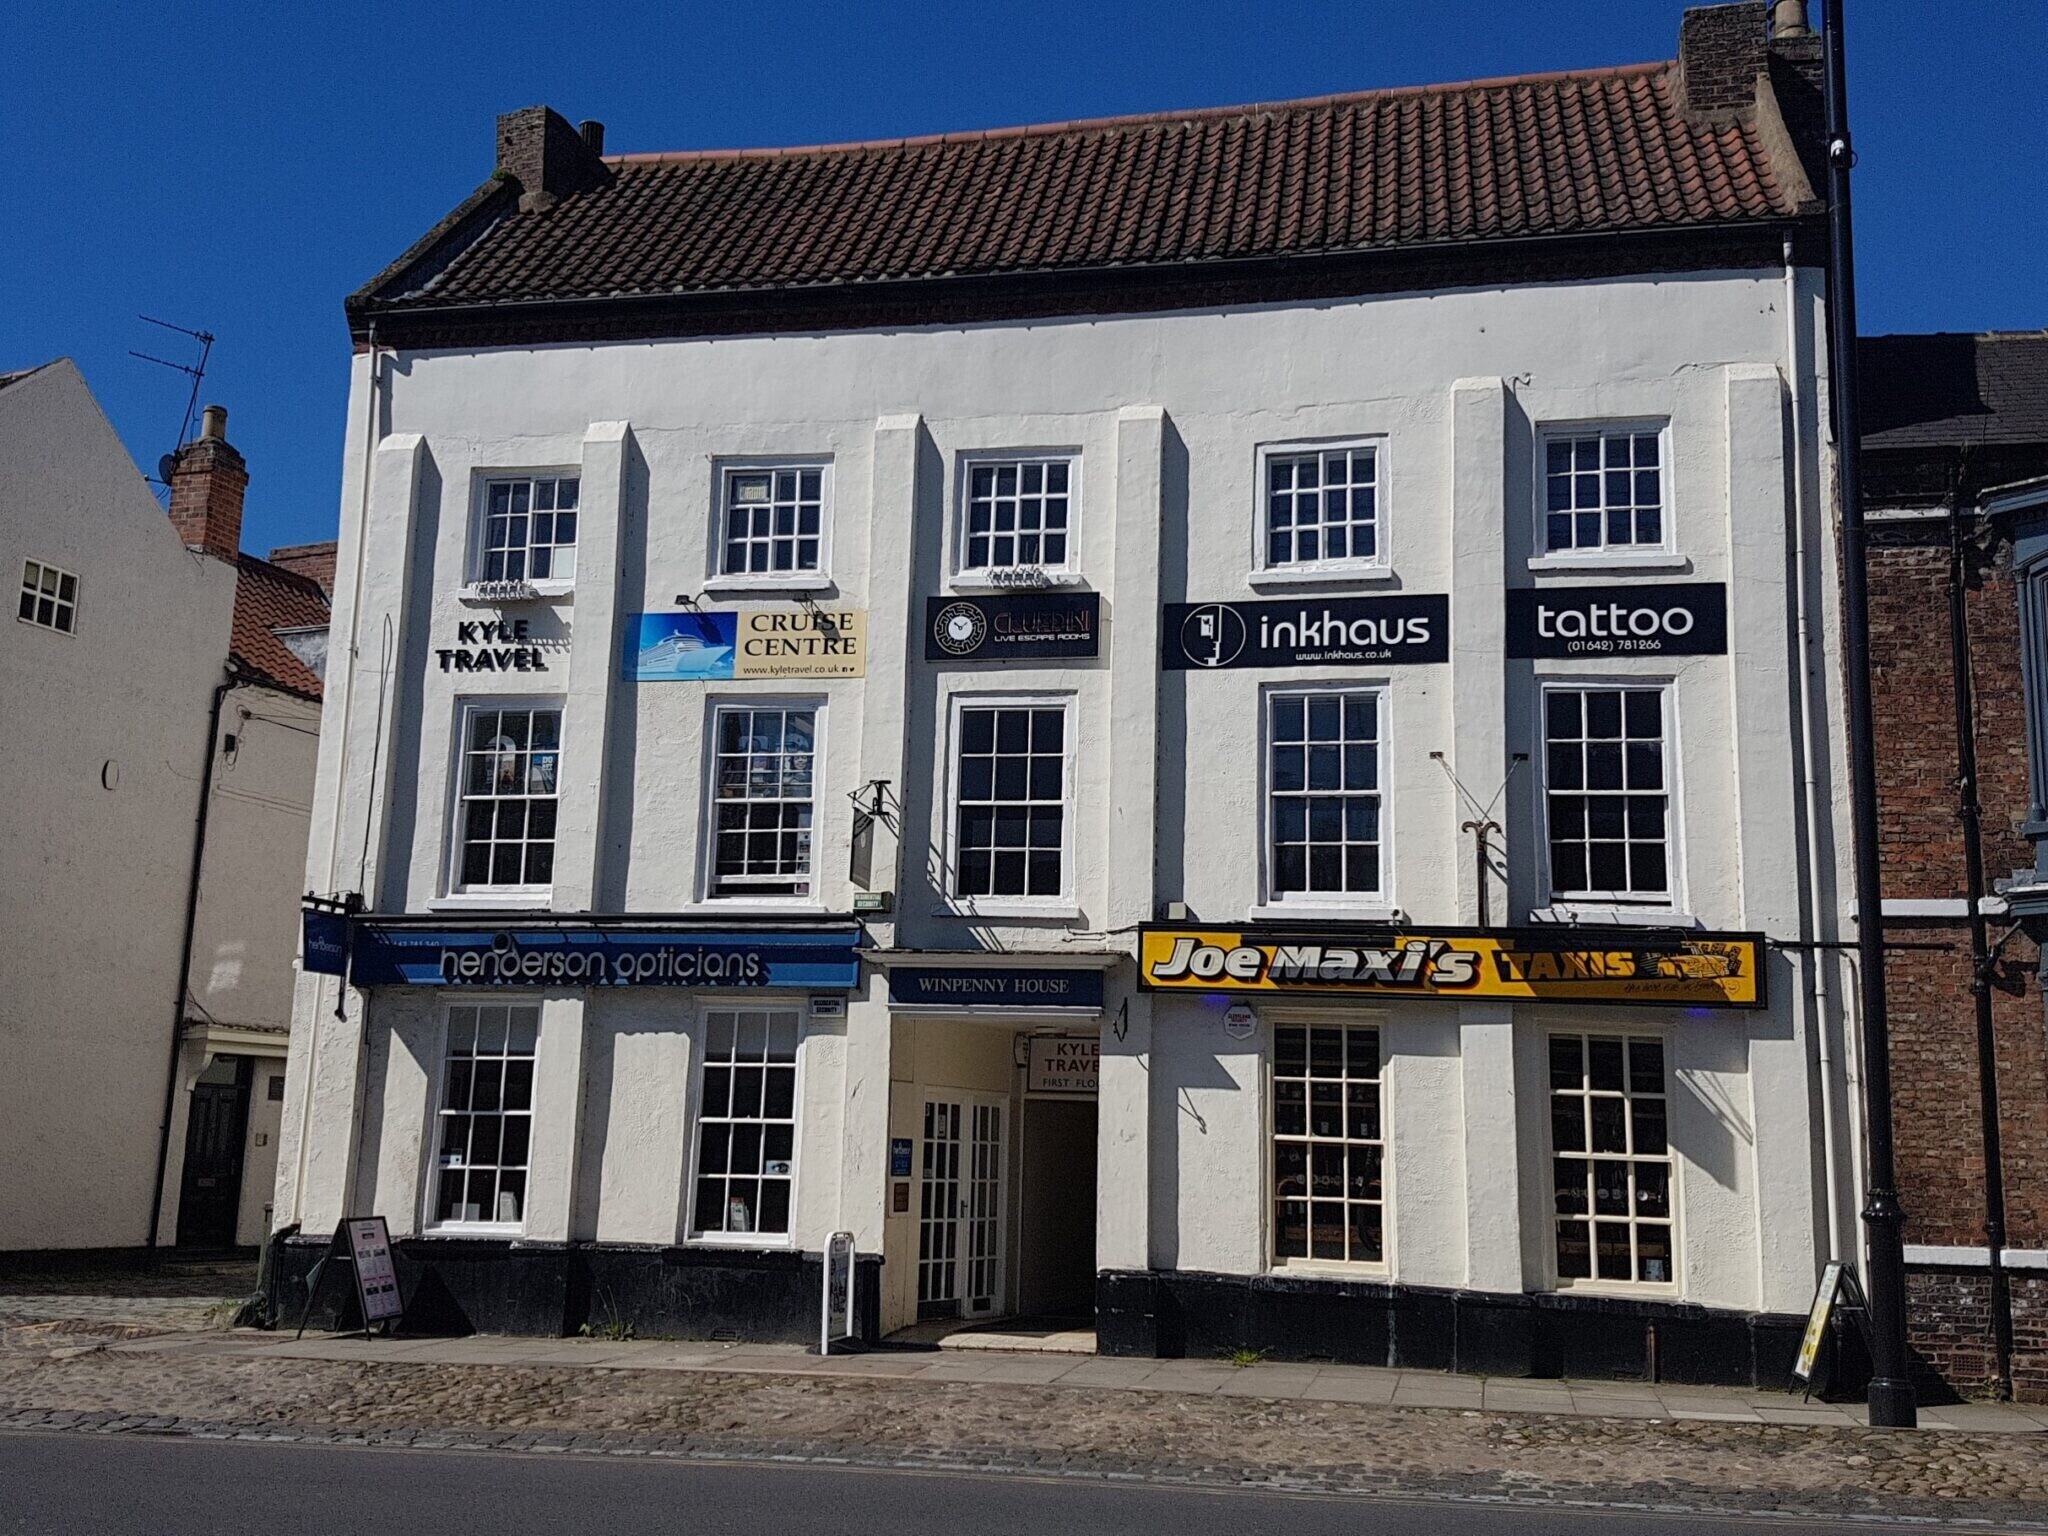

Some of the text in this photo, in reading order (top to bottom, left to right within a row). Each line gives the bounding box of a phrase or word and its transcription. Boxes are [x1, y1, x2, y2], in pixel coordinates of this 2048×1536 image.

[751, 613, 854, 632] CRUISE
[1260, 610, 1430, 648] inkhaus
[1537, 603, 1694, 638] tattoo
[458, 620, 529, 642] KYLE
[994, 632, 1090, 643] LIVE ESCAPE ROOMS
[744, 637, 857, 656] CENTRE
[1567, 639, 1662, 653] (01642) 781266
[435, 648, 546, 671] TRAVEL
[1295, 649, 1392, 661] www.inkhaus.co.uk
[743, 664, 839, 676] www.kyletravel.co.uk
[439, 932, 759, 982] henderson opticians
[1152, 938, 1636, 983] Joe Maxi's TAXIS
[918, 978, 1070, 993] WINPENNY HOUSE
[1057, 1043, 1100, 1056] KYLE
[1044, 1059, 1100, 1072] TRAVE
[1043, 1078, 1069, 1088] FIRST
